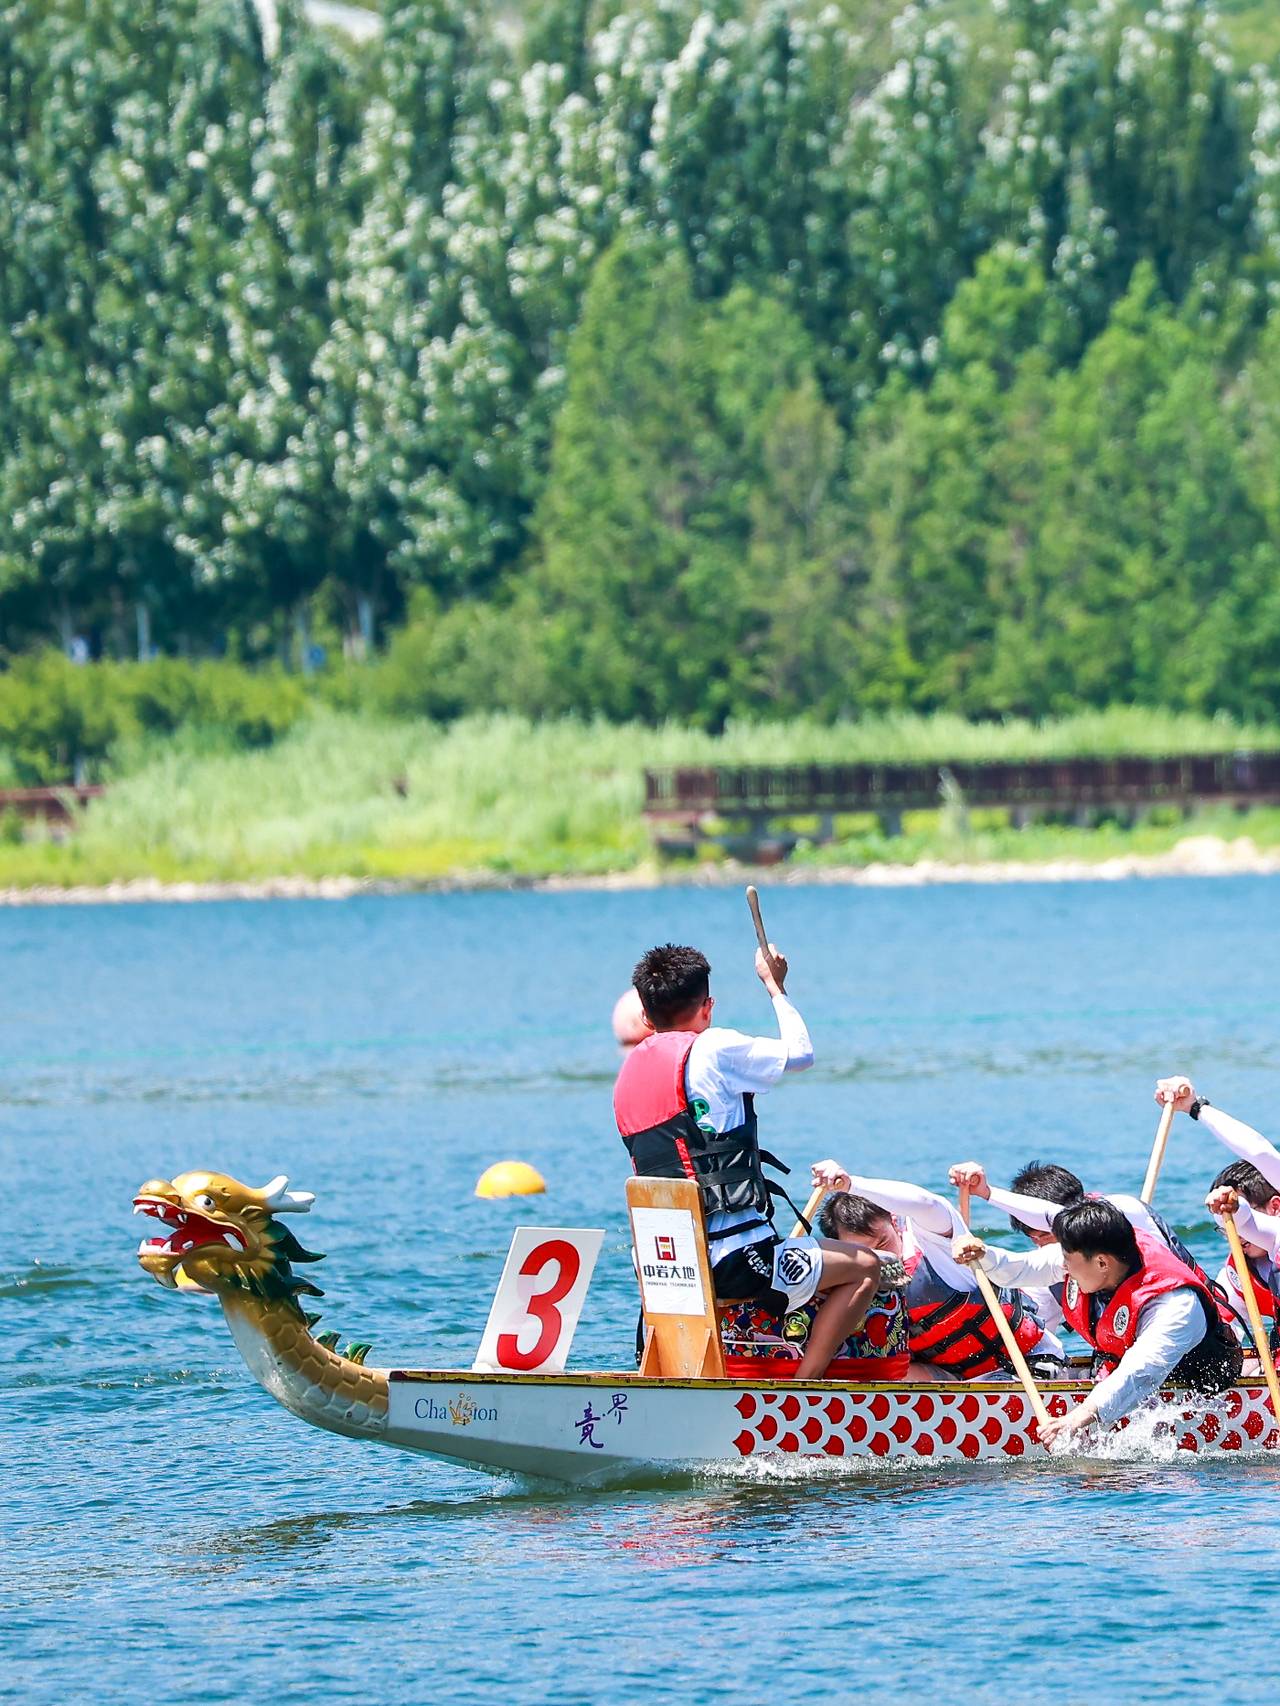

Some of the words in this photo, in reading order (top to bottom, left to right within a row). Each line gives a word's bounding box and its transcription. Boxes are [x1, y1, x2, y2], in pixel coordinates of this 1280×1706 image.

[497, 1239, 580, 1371] 3
[643, 1264, 696, 1281] 中岩大地
